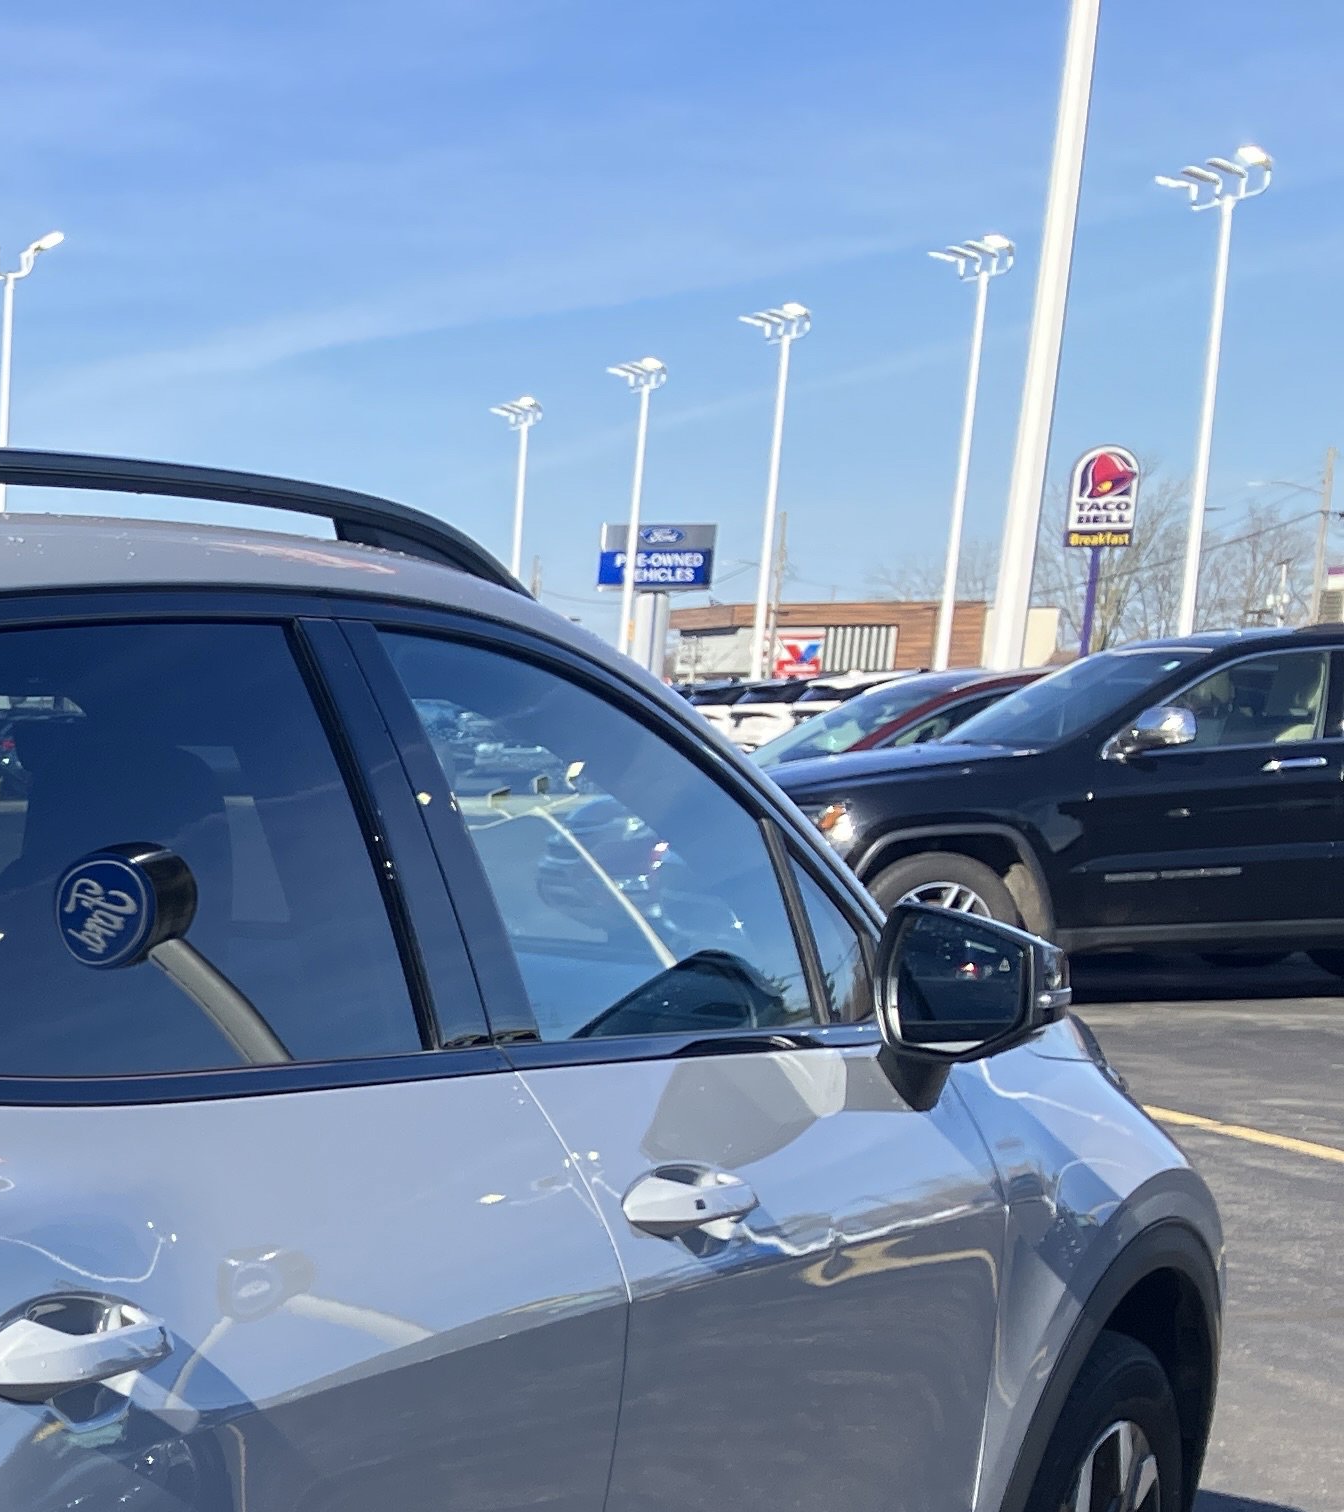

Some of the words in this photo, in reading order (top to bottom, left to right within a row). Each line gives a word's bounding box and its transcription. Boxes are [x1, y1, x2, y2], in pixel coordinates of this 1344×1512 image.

[1076, 501, 1132, 512] TACO
[1077, 513, 1132, 524] BELL
[1068, 531, 1130, 546] Breakfast
[614, 552, 704, 568] PE-OWNED
[627, 567, 695, 582] EHICLES
